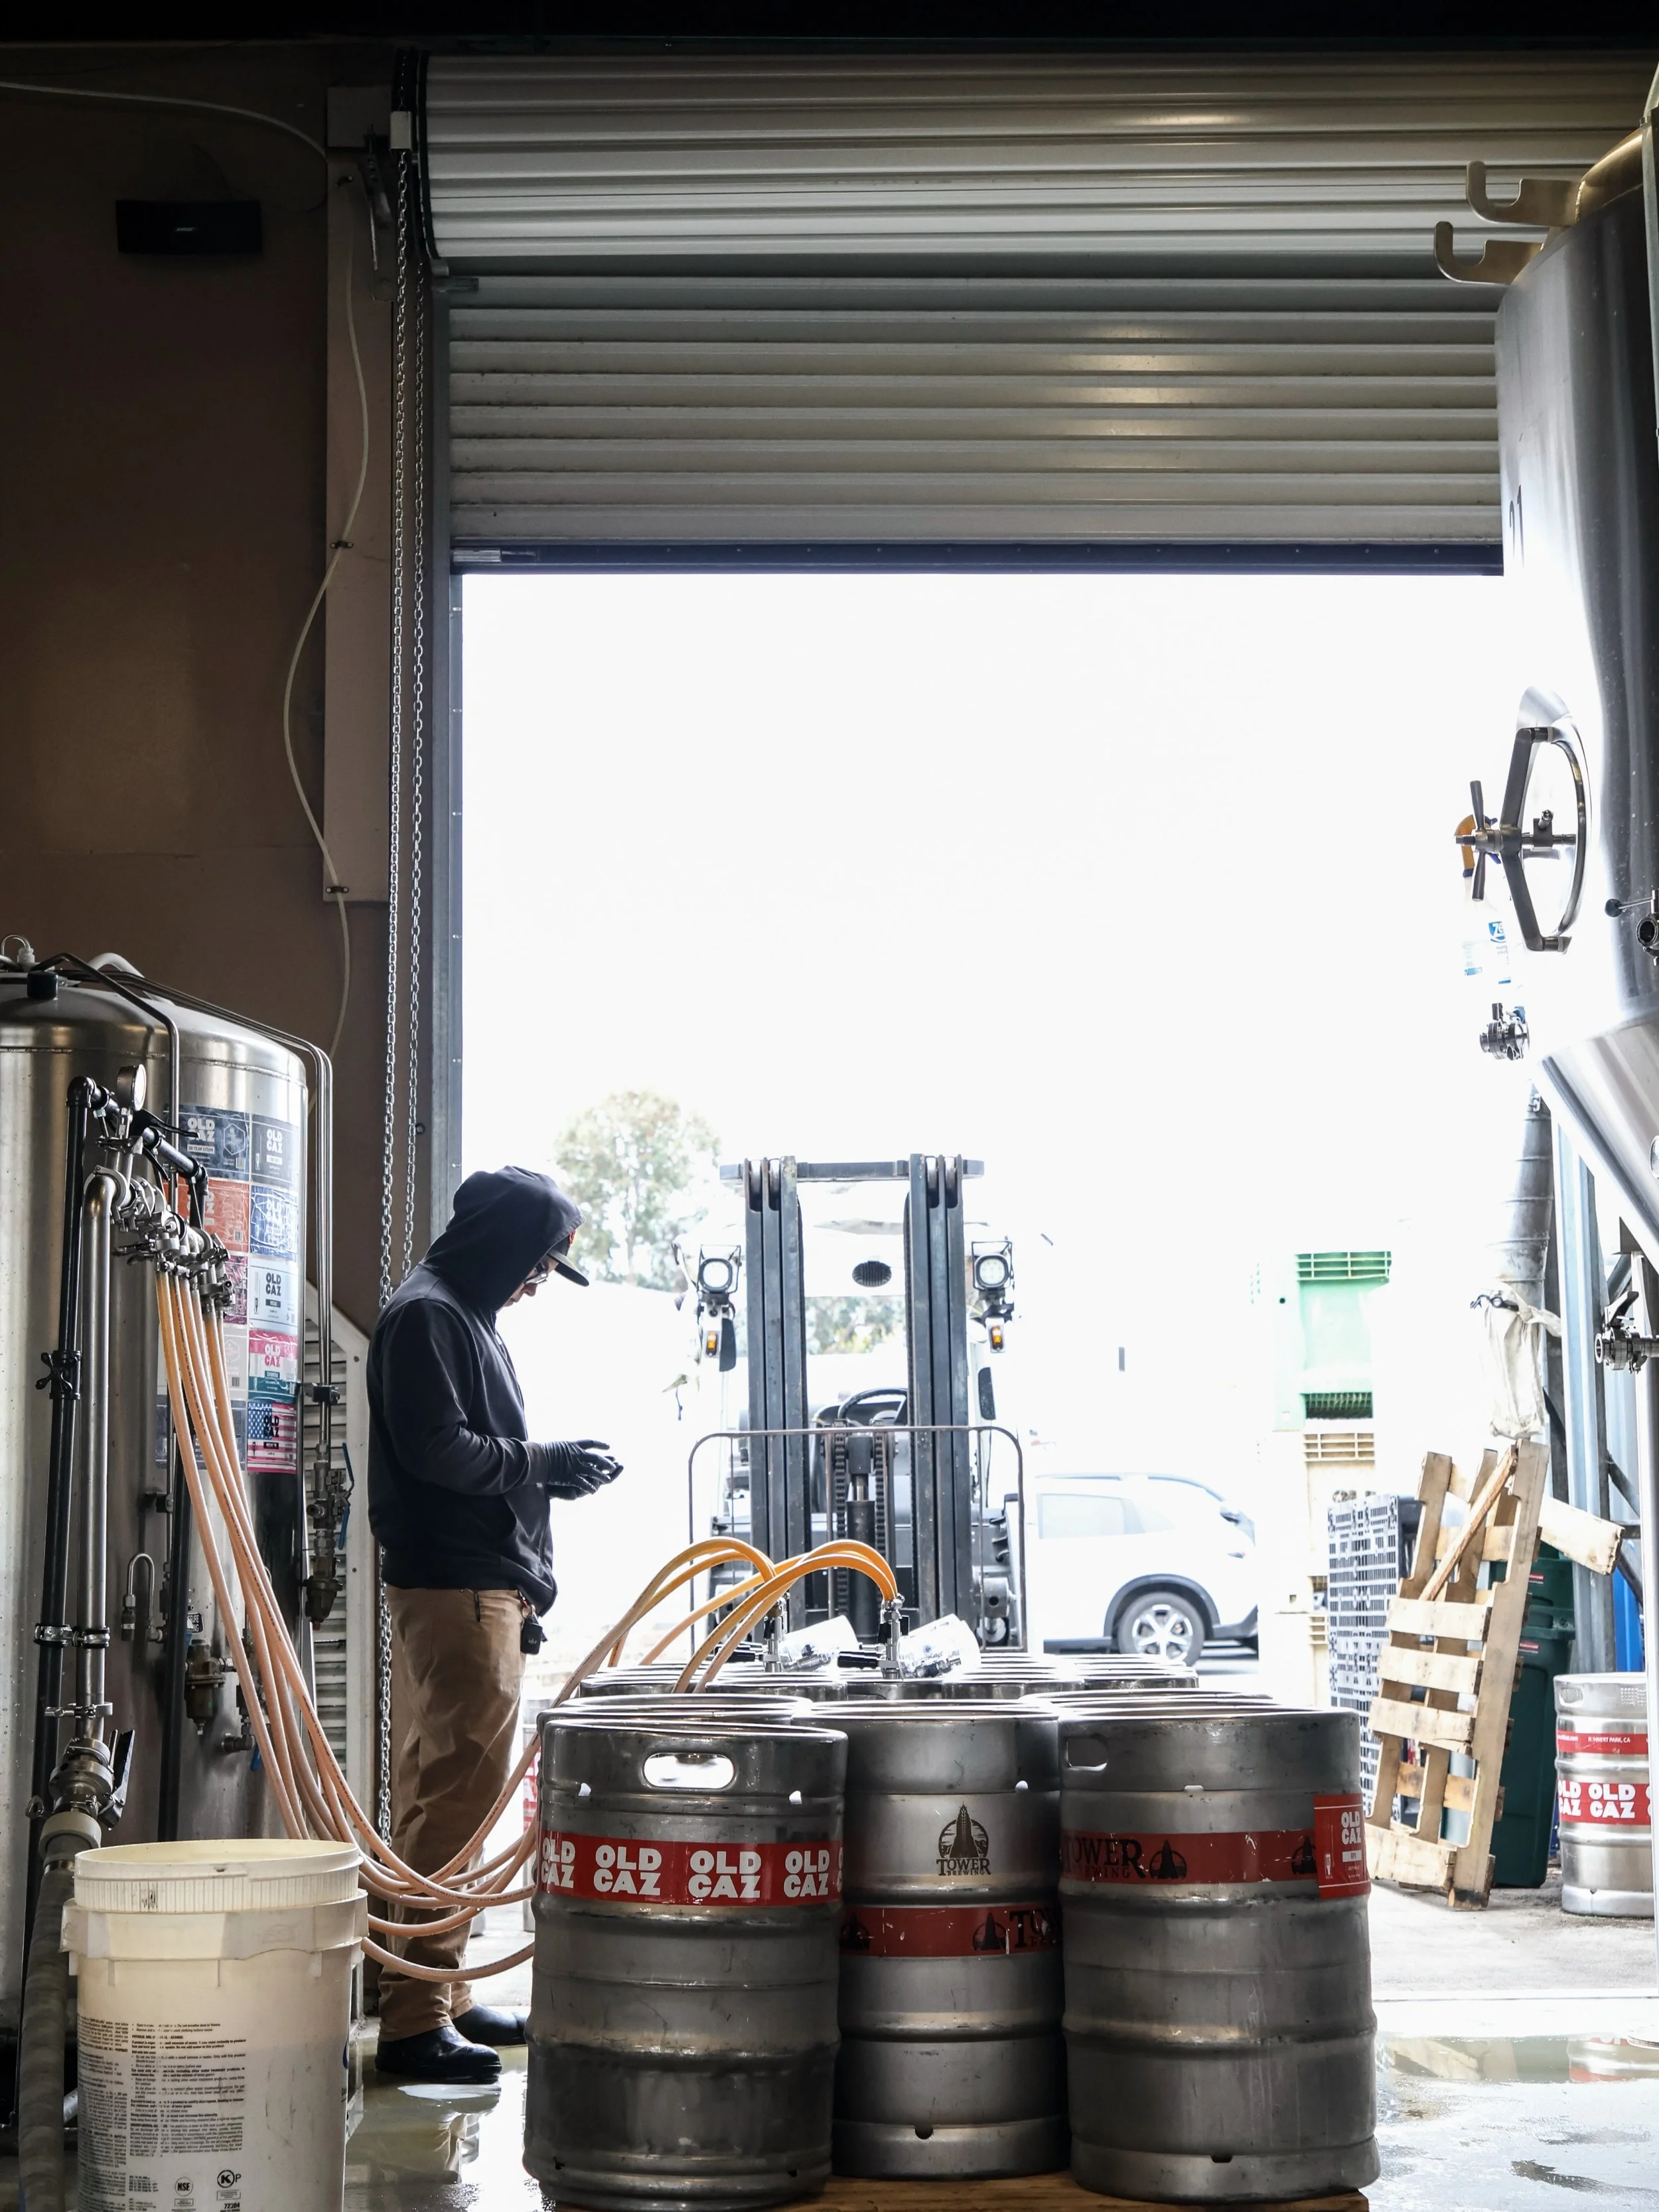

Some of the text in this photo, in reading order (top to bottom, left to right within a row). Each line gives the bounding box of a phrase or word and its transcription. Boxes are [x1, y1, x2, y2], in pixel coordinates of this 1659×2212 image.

[187, 1117, 215, 1131] OLD
[266, 1129, 283, 1142] OLD
[266, 1140, 283, 1154] CAZ
[265, 1273, 281, 1284] OLD
[265, 1283, 281, 1296] CAZ
[265, 1343, 280, 1356] OLD
[265, 1355, 280, 1367] CAZ
[263, 1415, 279, 1426] OLD
[1588, 1783, 1636, 1801] OLD
[1589, 1801, 1636, 1819] CAZ
[1341, 1811, 1360, 1829] OLD
[1342, 1828, 1361, 1844] CAZ
[542, 1837, 575, 1863] OLD
[595, 1844, 662, 1870] OLD
[689, 1850, 762, 1874] OLD
[784, 1849, 830, 1874] OLD
[1063, 1835, 1146, 1879] TOWER
[936, 1858, 991, 1876] TOWER
[541, 1861, 829, 1898] CAZ CAZ CAZ CAZ
[177, 2182, 190, 2191] NSF
